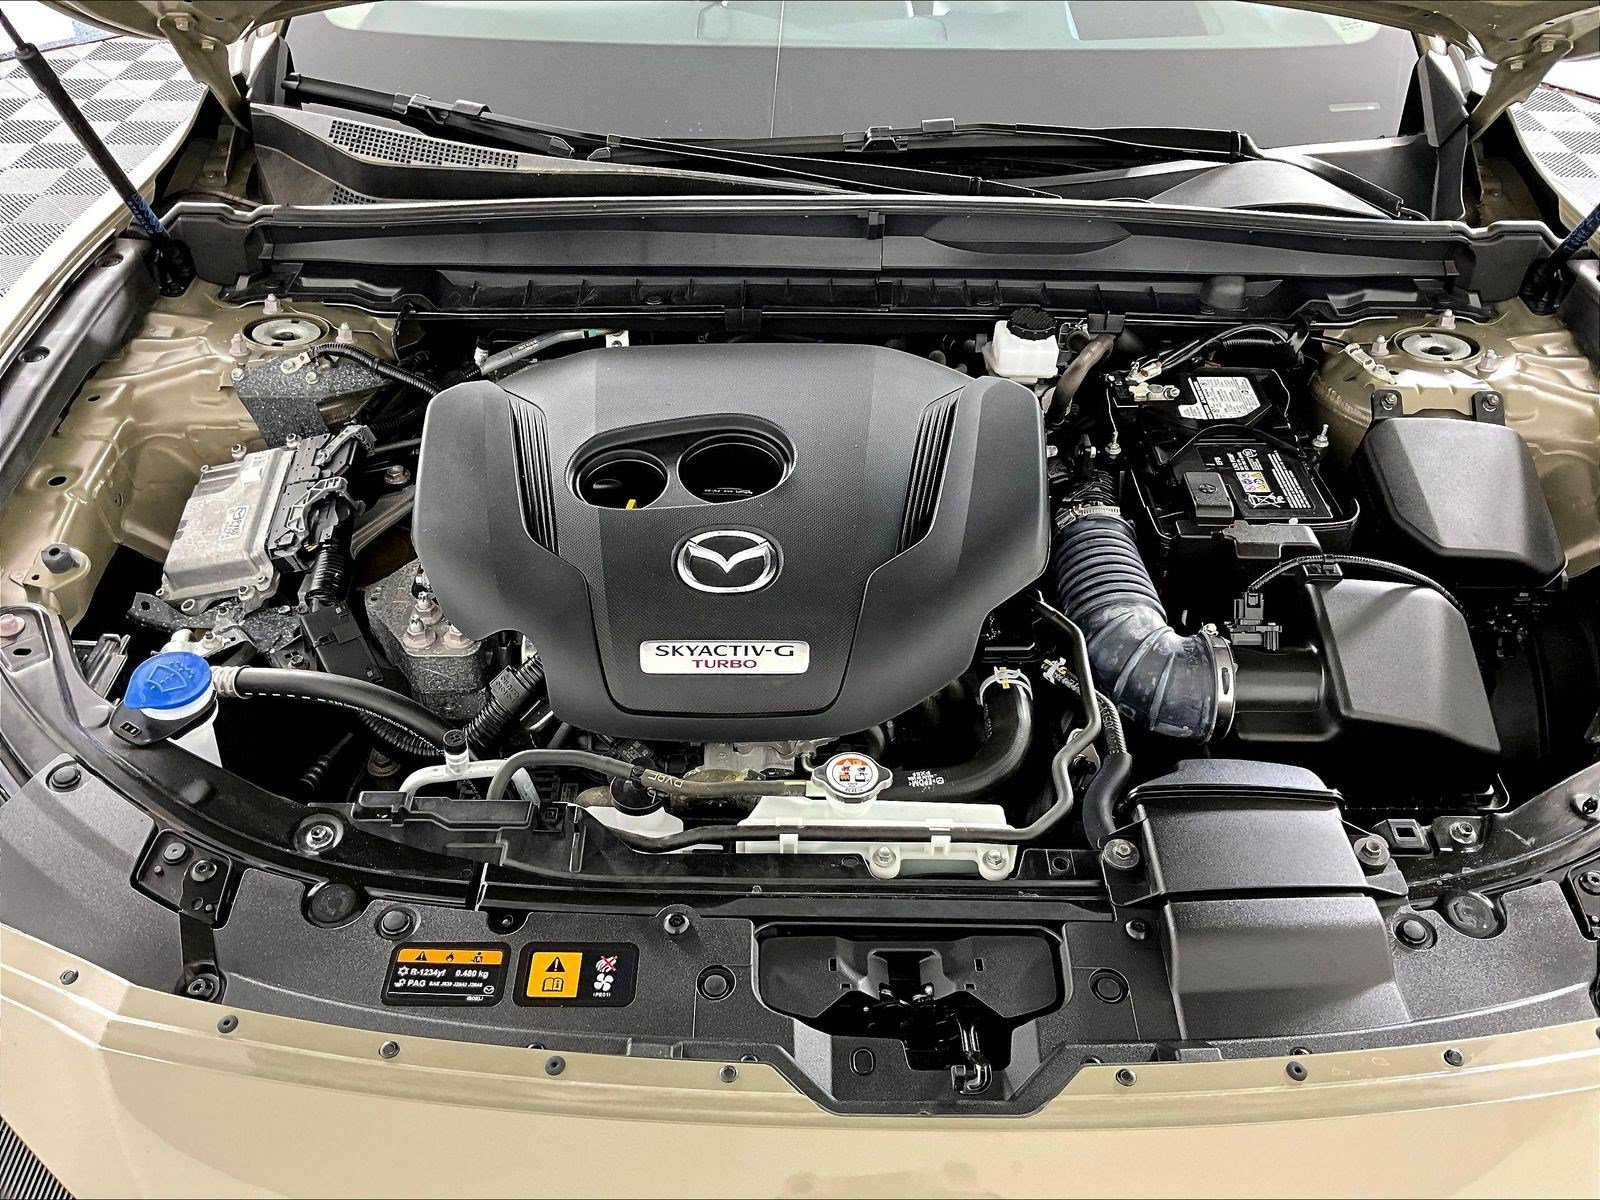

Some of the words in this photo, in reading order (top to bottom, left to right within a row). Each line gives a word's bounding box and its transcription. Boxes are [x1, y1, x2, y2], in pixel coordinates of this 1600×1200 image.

[655, 644, 795, 657] SKYACTIV-G
[692, 659, 758, 669] TURBO
[410, 968, 447, 978] R-1234yf
[455, 969, 478, 977] 0.480
[478, 969, 489, 979] kg
[407, 979, 426, 987] PAG
